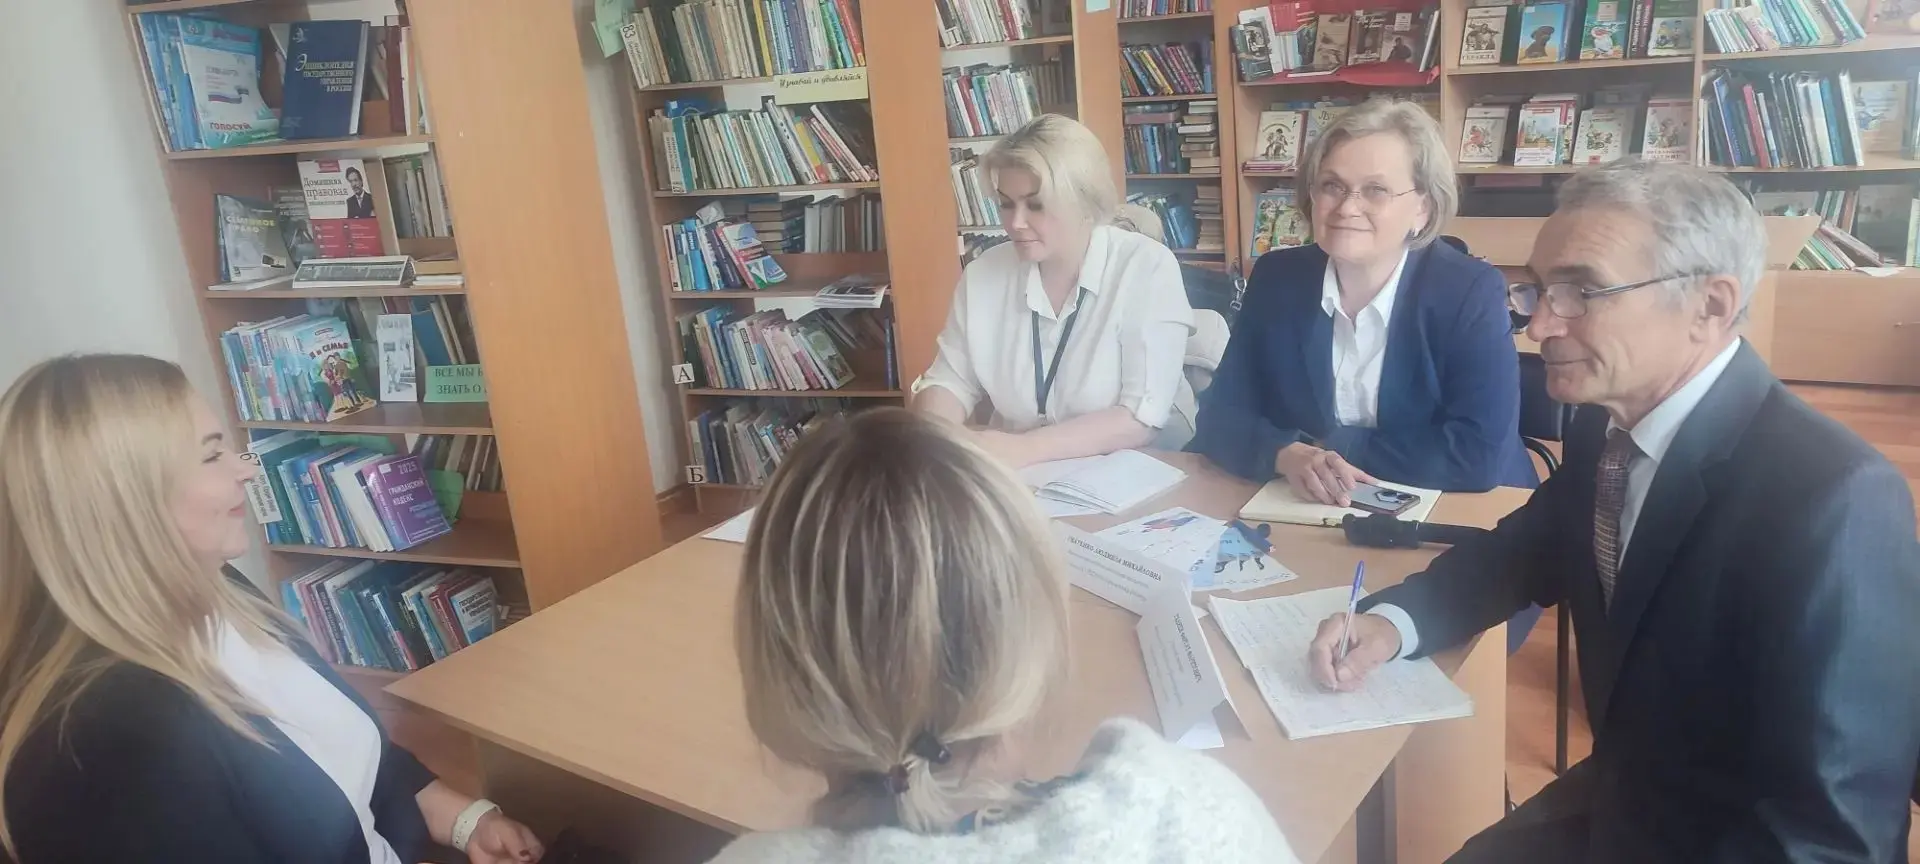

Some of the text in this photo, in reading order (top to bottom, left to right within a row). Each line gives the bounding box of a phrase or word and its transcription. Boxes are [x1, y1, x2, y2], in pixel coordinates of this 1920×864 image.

[622, 24, 636, 39] 83
[305, 187, 349, 201] правовая
[435, 367, 454, 377] ВСЕ
[456, 367, 475, 377] МЫ
[678, 366, 692, 382] А
[437, 384, 481, 395] ЗНАТЬ О
[397, 461, 418, 475] 2025
[689, 467, 704, 482] Б
[1122, 559, 1162, 582] МИХАЙЛОВНА
